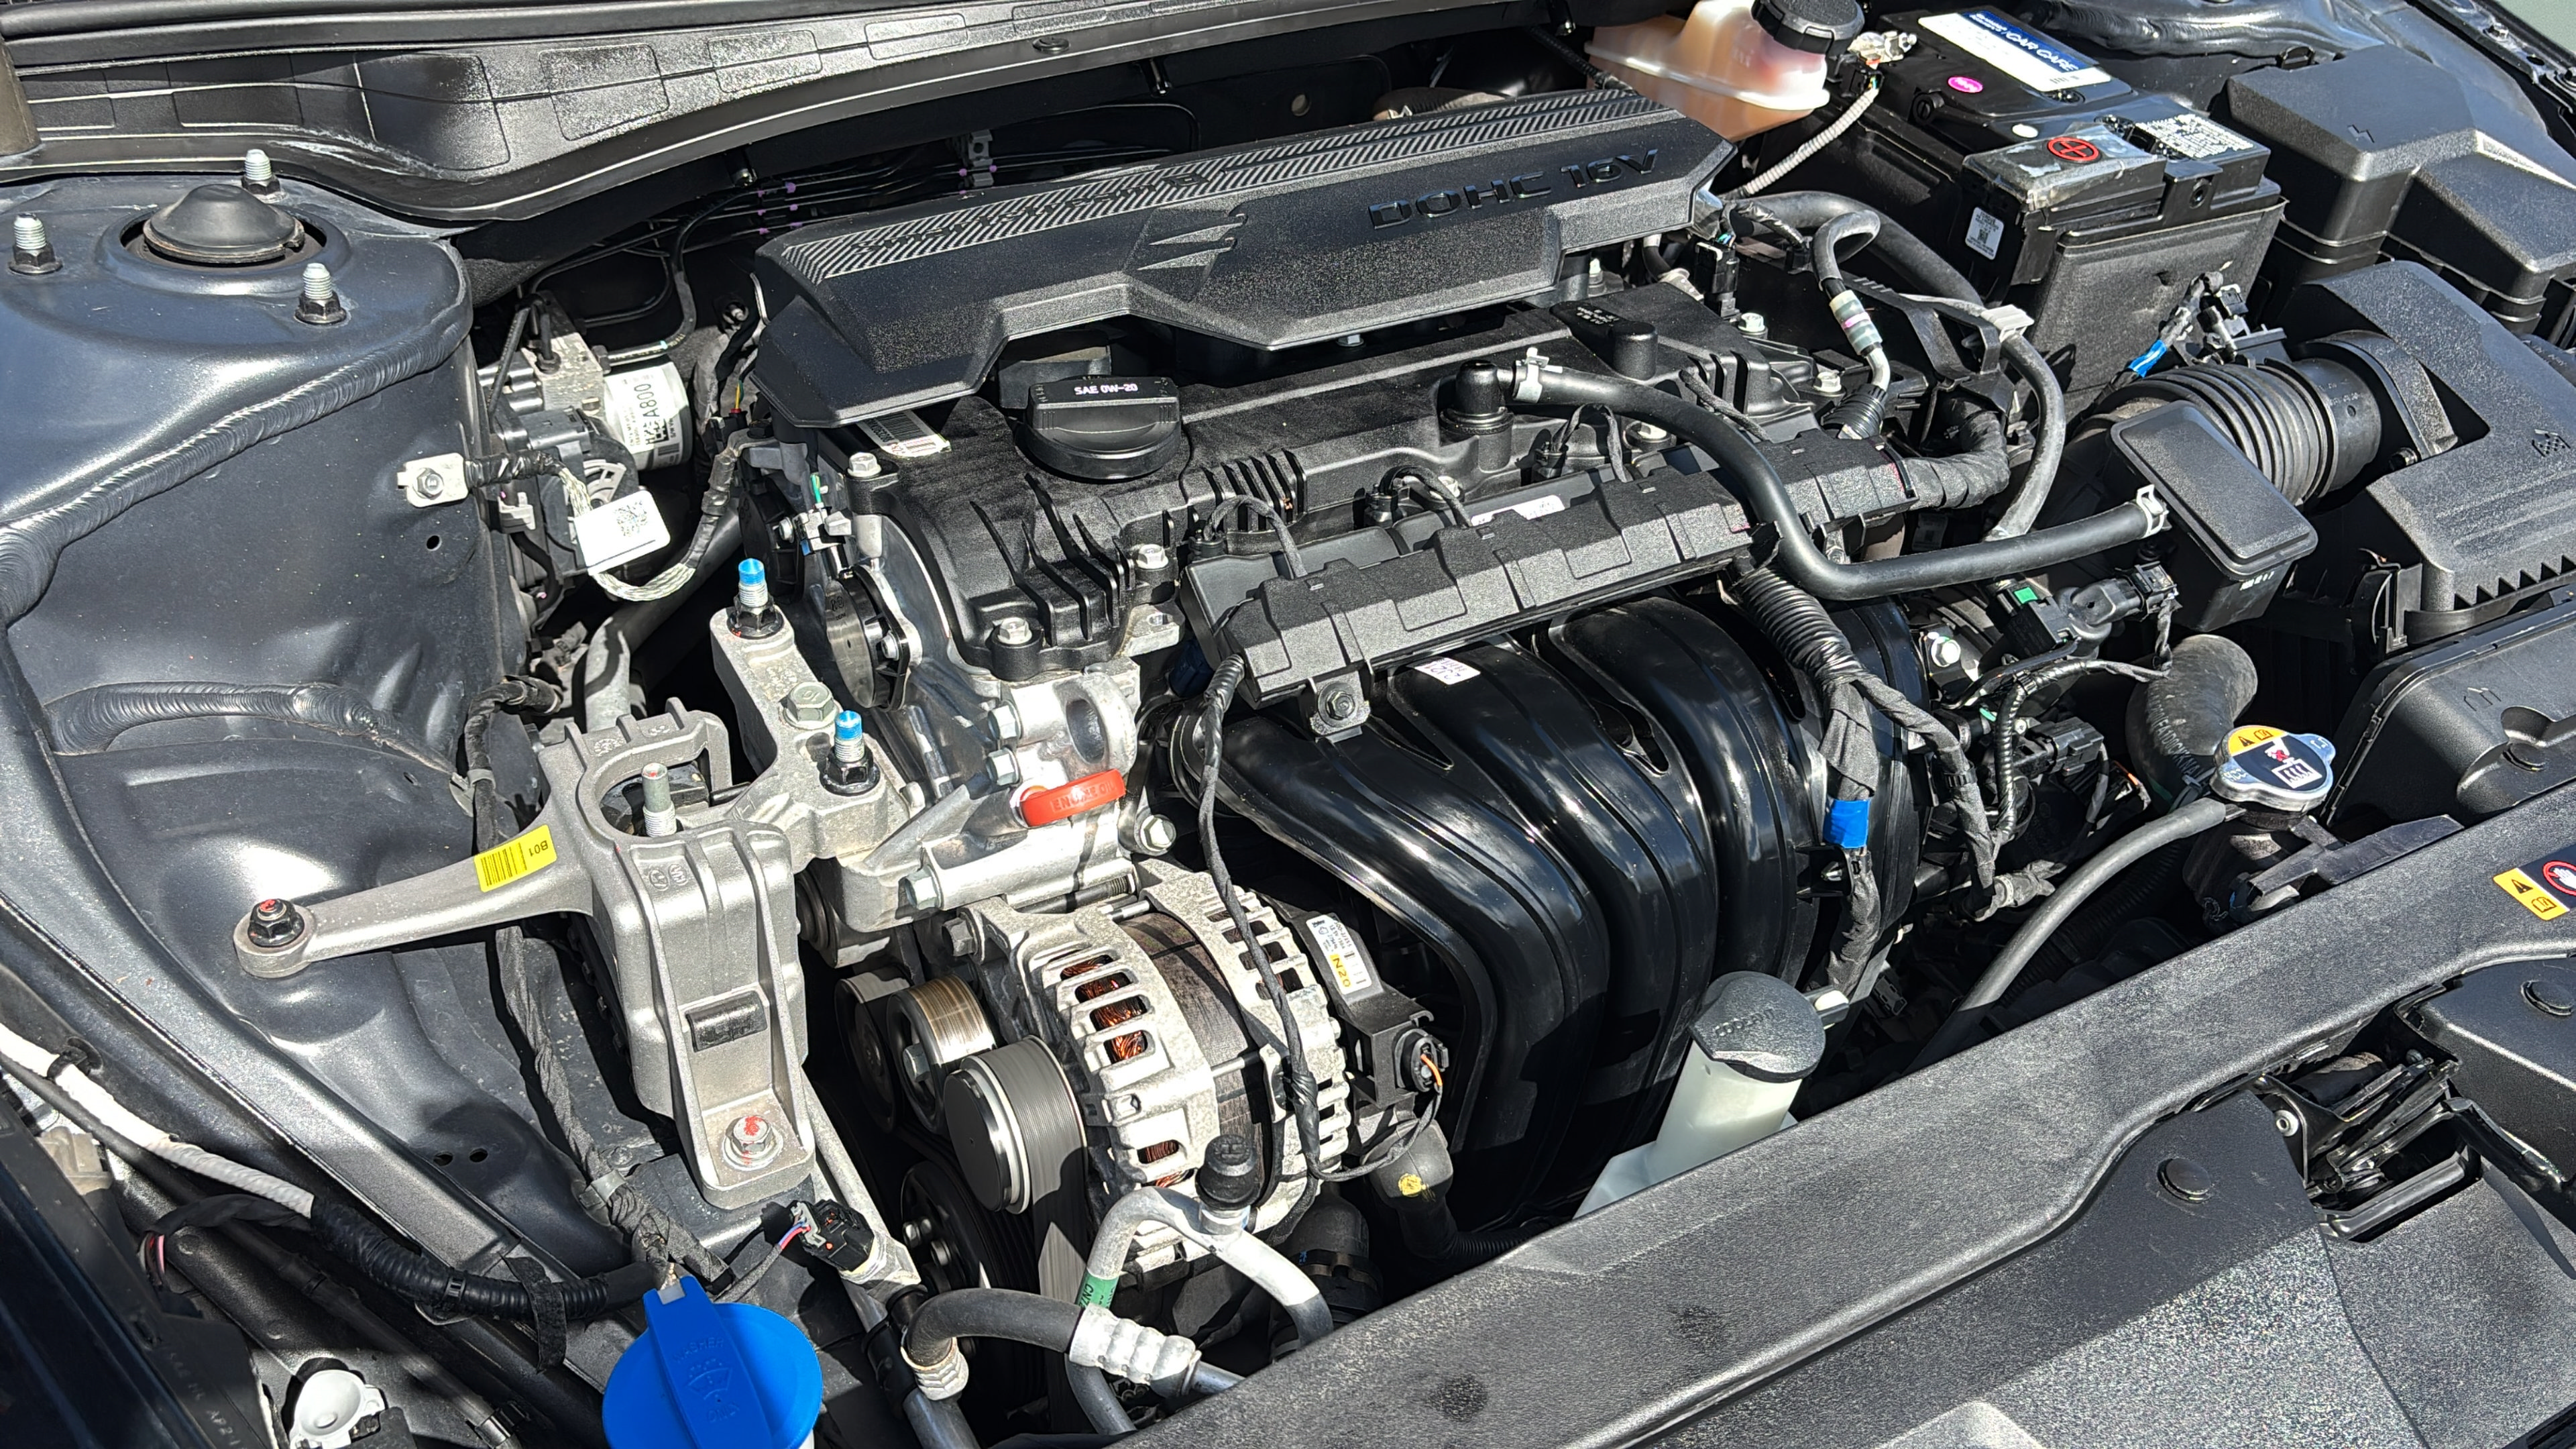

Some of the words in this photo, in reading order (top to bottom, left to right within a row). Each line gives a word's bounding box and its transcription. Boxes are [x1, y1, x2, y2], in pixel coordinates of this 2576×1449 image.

[1367, 169, 1553, 230] DOHC
[1560, 148, 1659, 189] 16V
[1073, 385, 1100, 396] SAE
[1100, 383, 1139, 394] 0W-20
[1098, 780, 1119, 795] OIL
[528, 839, 549, 857] B01
[1332, 957, 1351, 988] N20
[673, 1336, 724, 1364] WASHER
[708, 1402, 740, 1424] ONLY
